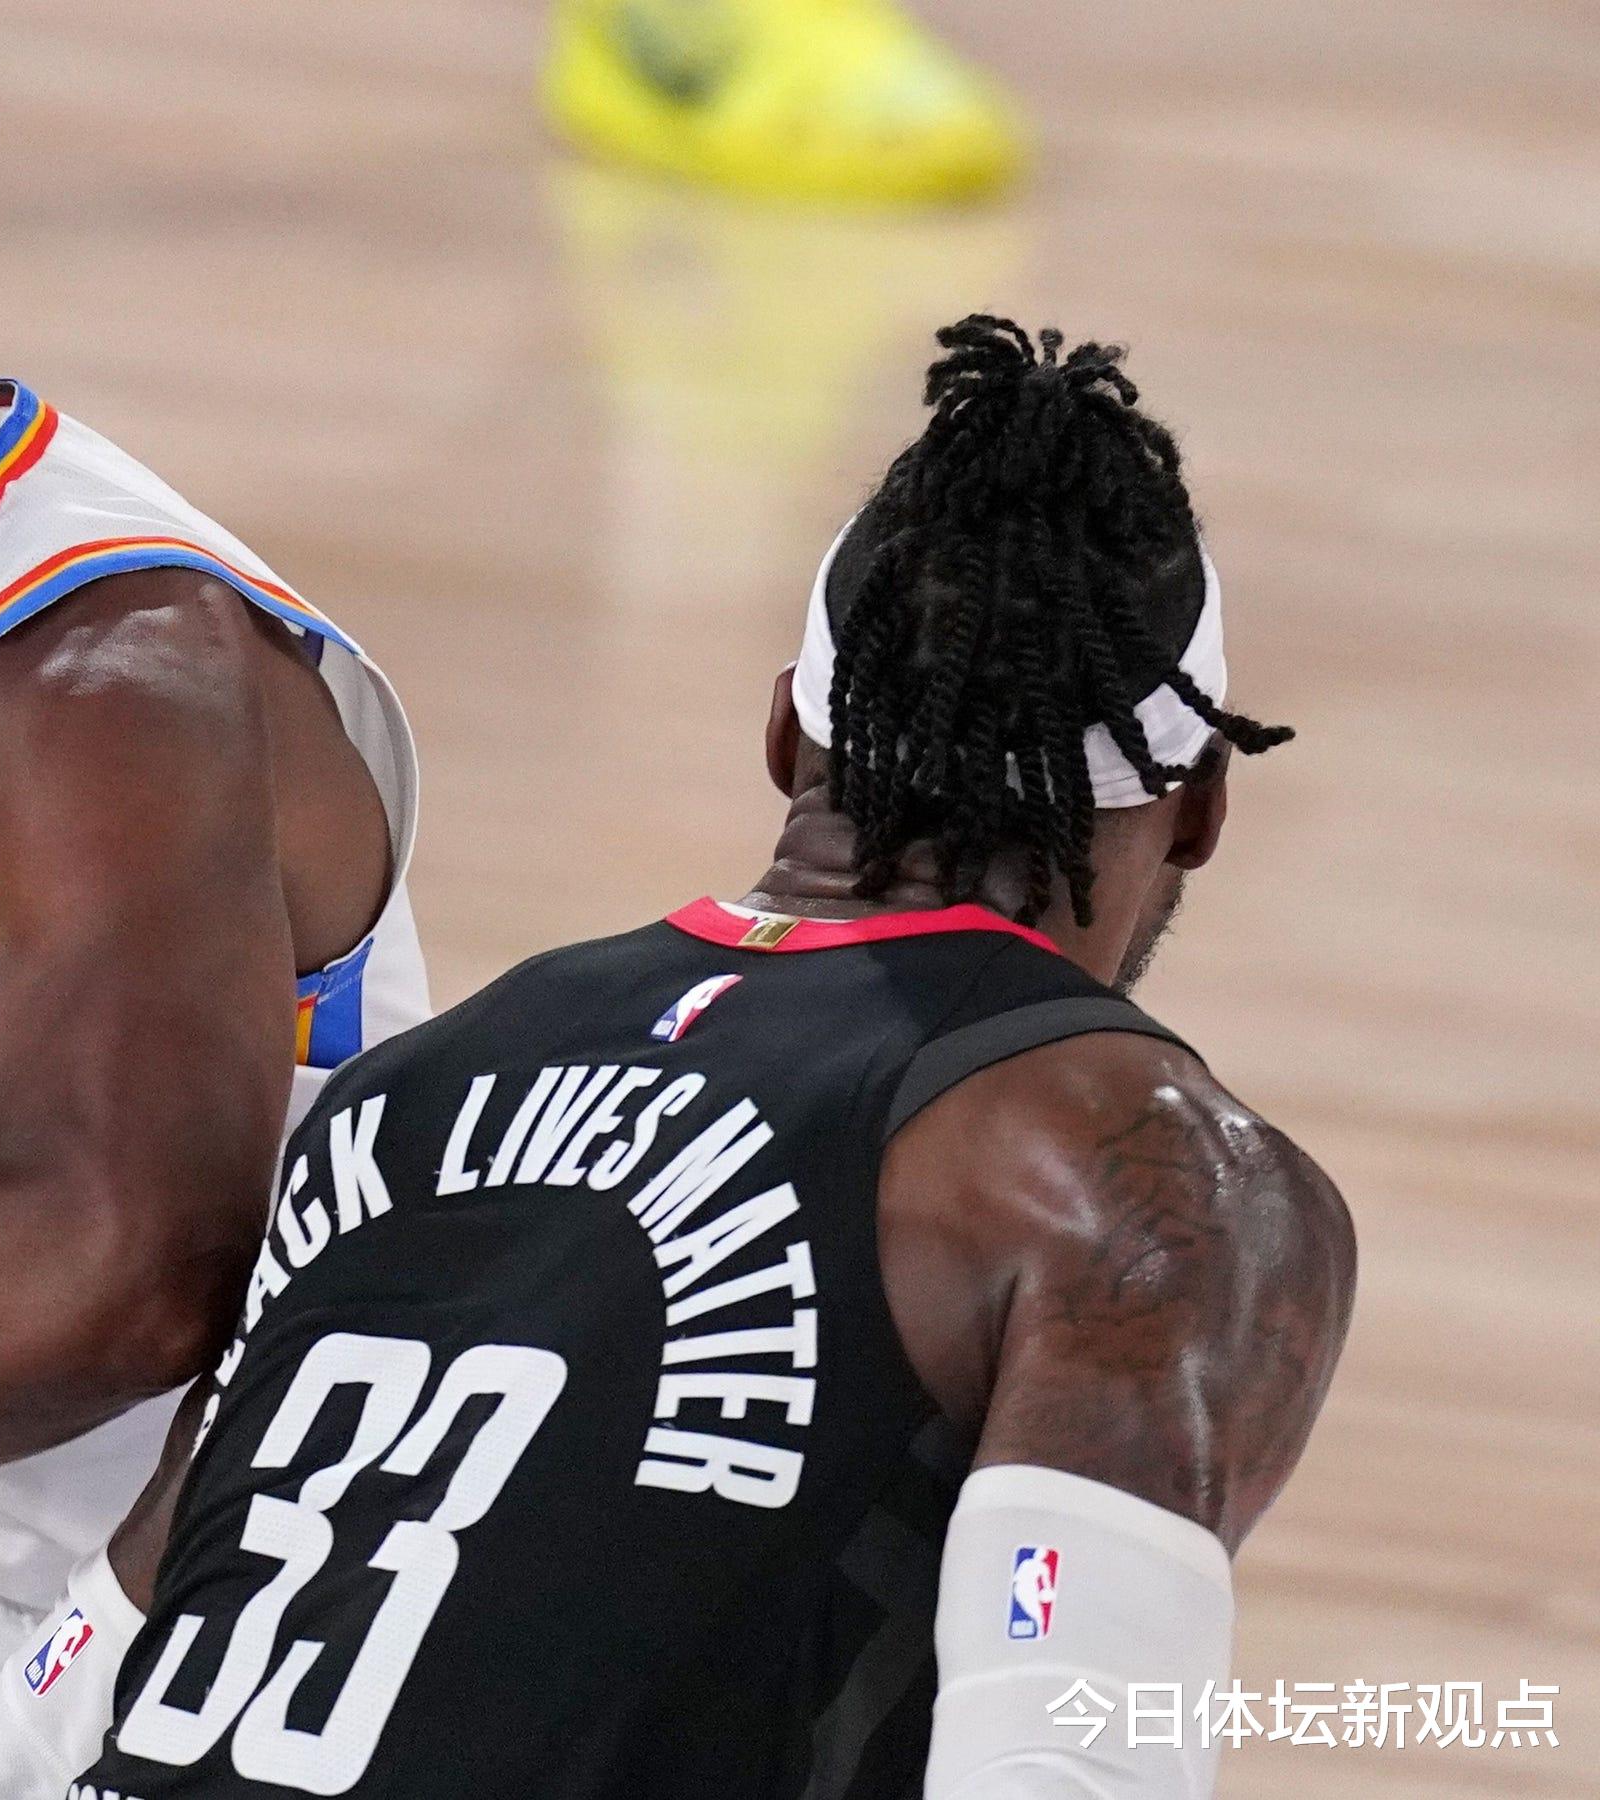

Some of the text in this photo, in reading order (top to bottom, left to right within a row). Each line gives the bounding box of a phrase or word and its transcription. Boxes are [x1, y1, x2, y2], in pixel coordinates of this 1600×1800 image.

[190, 1064, 821, 1509] ACK LIVES MATTER
[116, 1331, 568, 1796] 33
